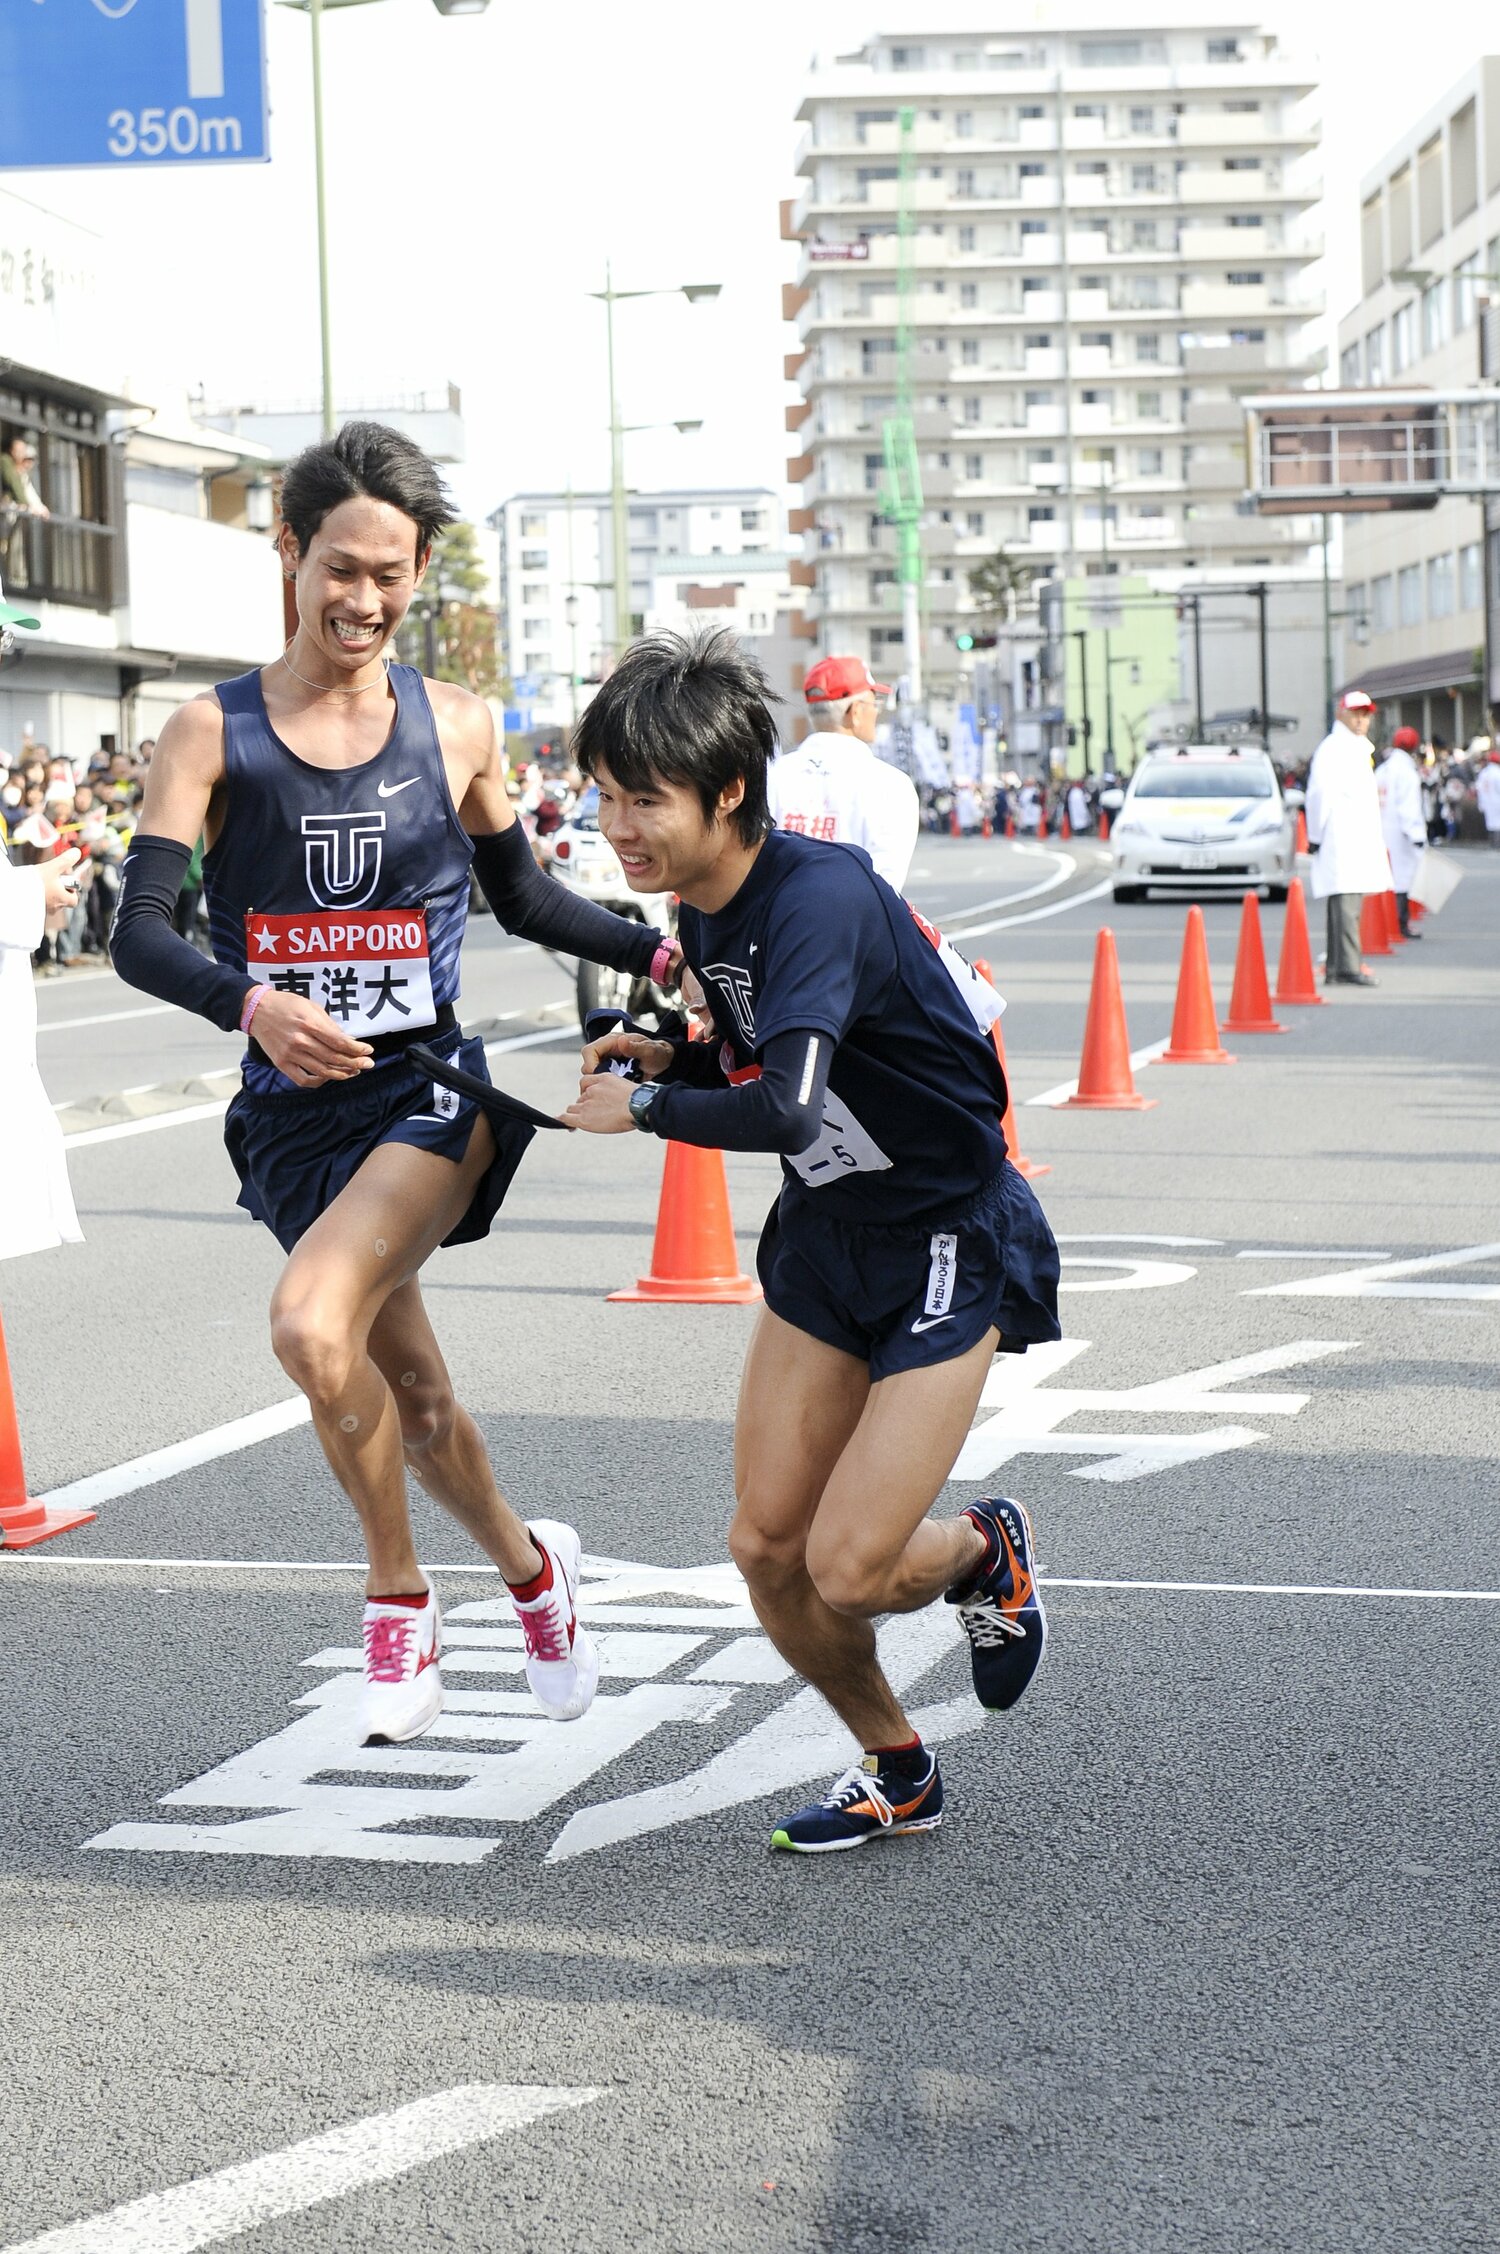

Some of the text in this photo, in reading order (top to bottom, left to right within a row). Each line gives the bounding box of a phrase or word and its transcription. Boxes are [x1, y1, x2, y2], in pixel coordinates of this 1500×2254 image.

[107, 106, 243, 157] 350m
[288, 922, 422, 955] SAPPORO
[932, 1240, 950, 1310] がんばろう日本
